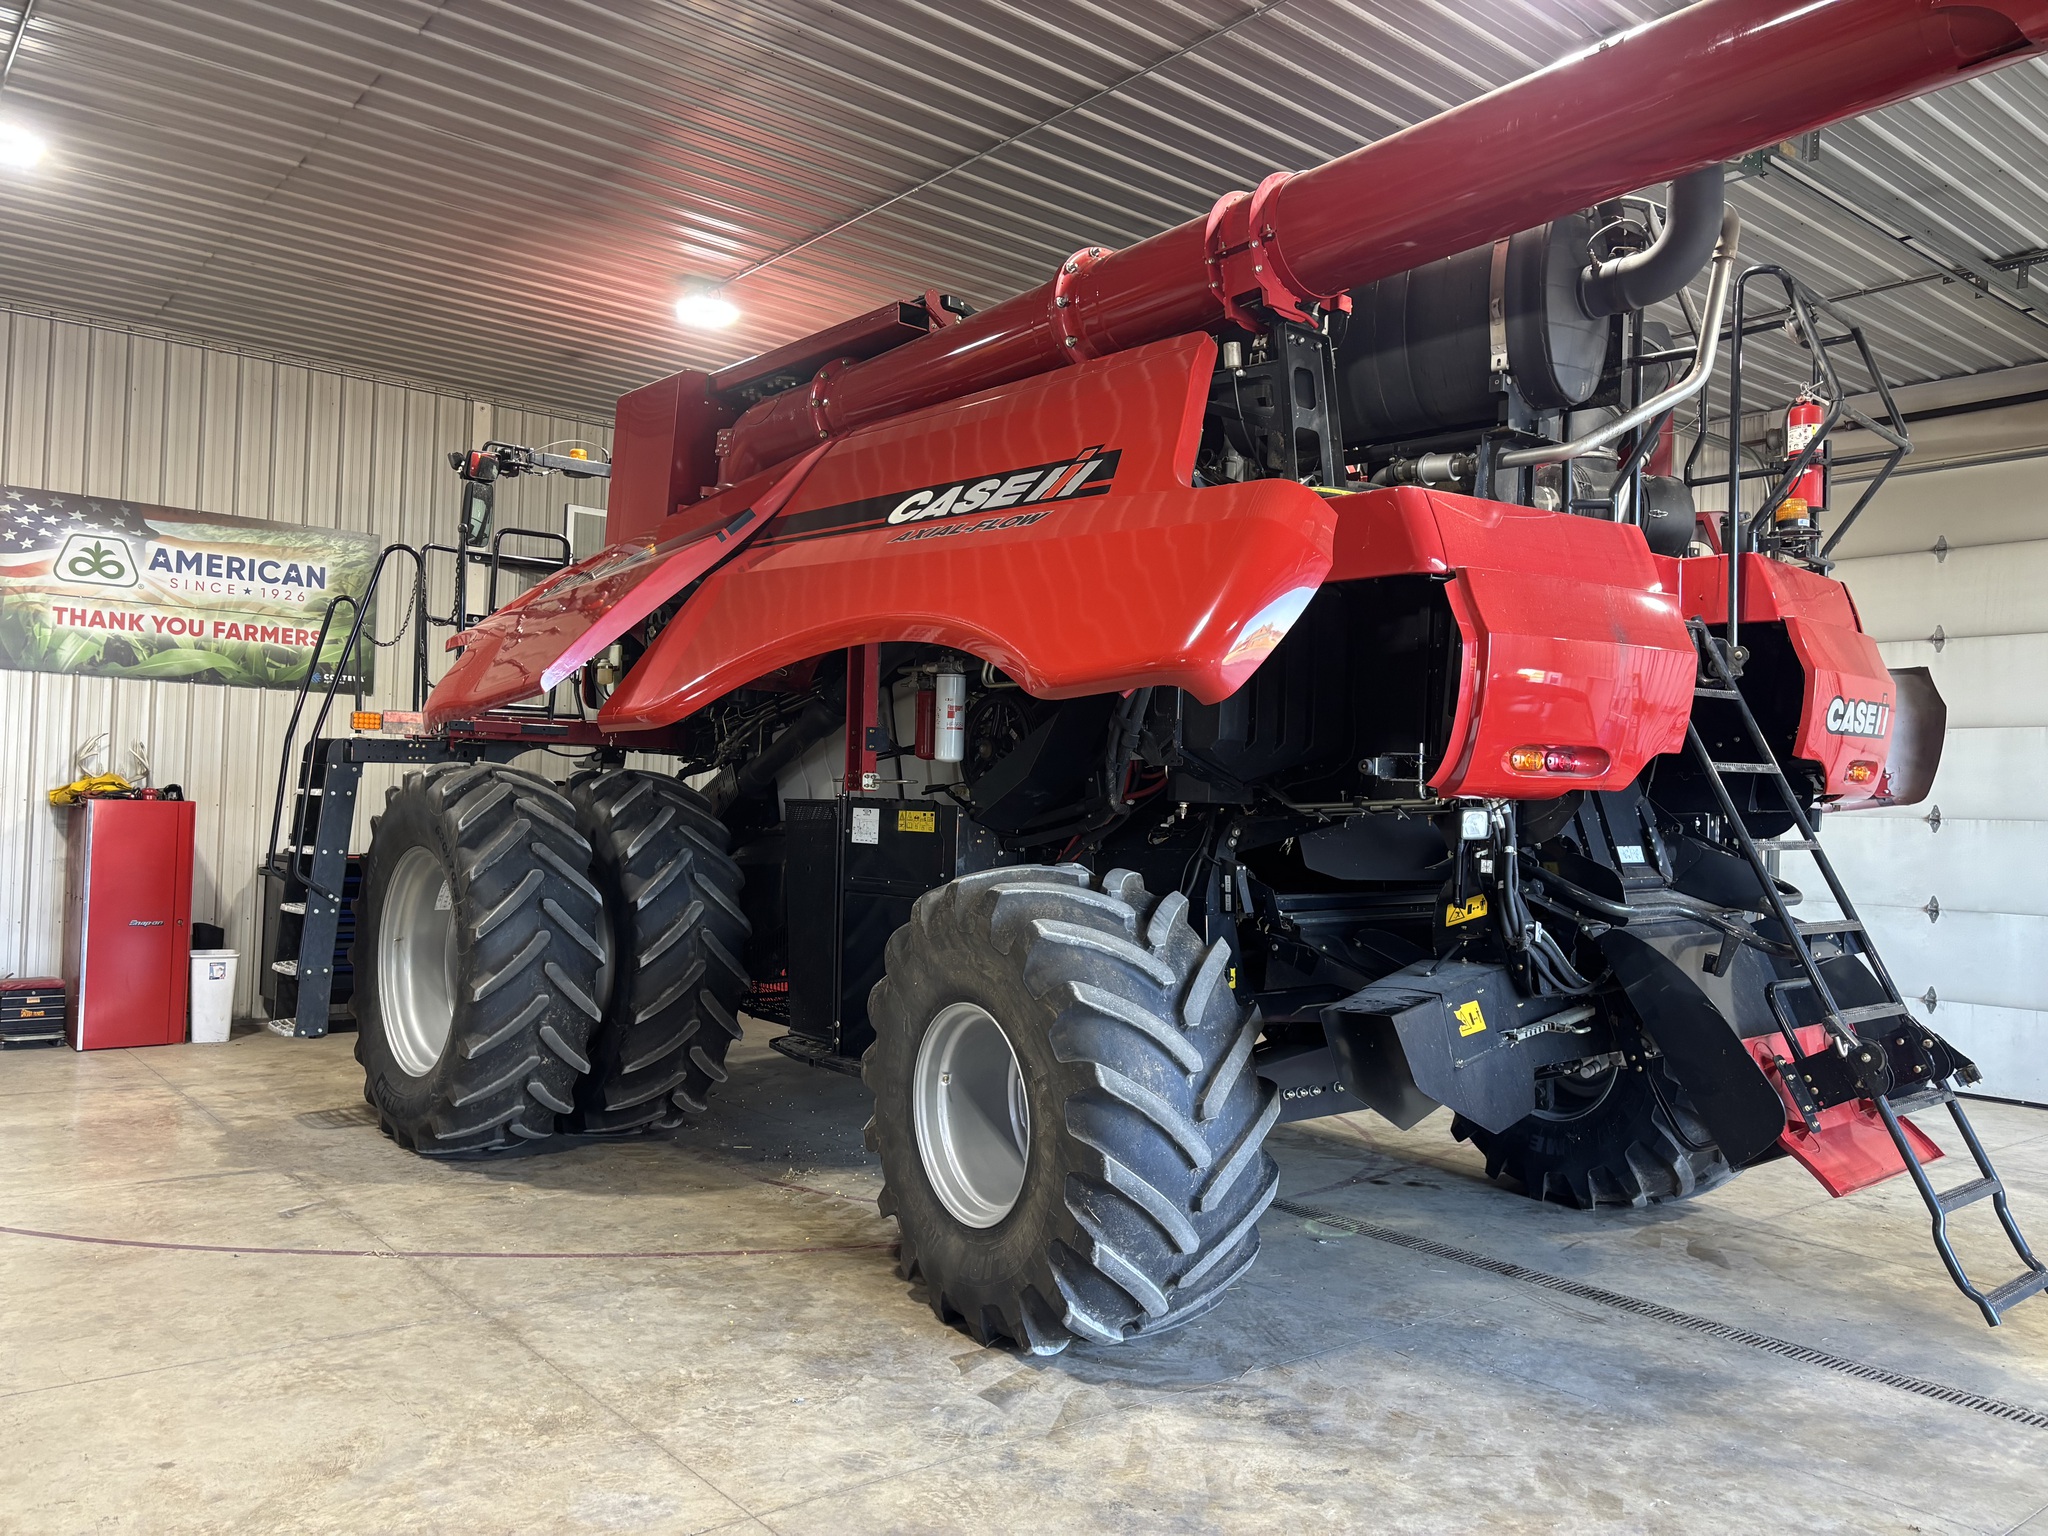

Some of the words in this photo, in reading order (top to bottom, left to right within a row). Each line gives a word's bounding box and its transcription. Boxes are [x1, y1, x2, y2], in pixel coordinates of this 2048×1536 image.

[887, 510, 1054, 543] AXIAL-FLOW
[148, 548, 326, 590] AMERICAN
[170, 578, 235, 595] SINCE
[261, 587, 305, 602] 1926
[52, 606, 145, 633] THANK
[151, 615, 204, 637] YOU
[213, 621, 320, 648] FARMERS
